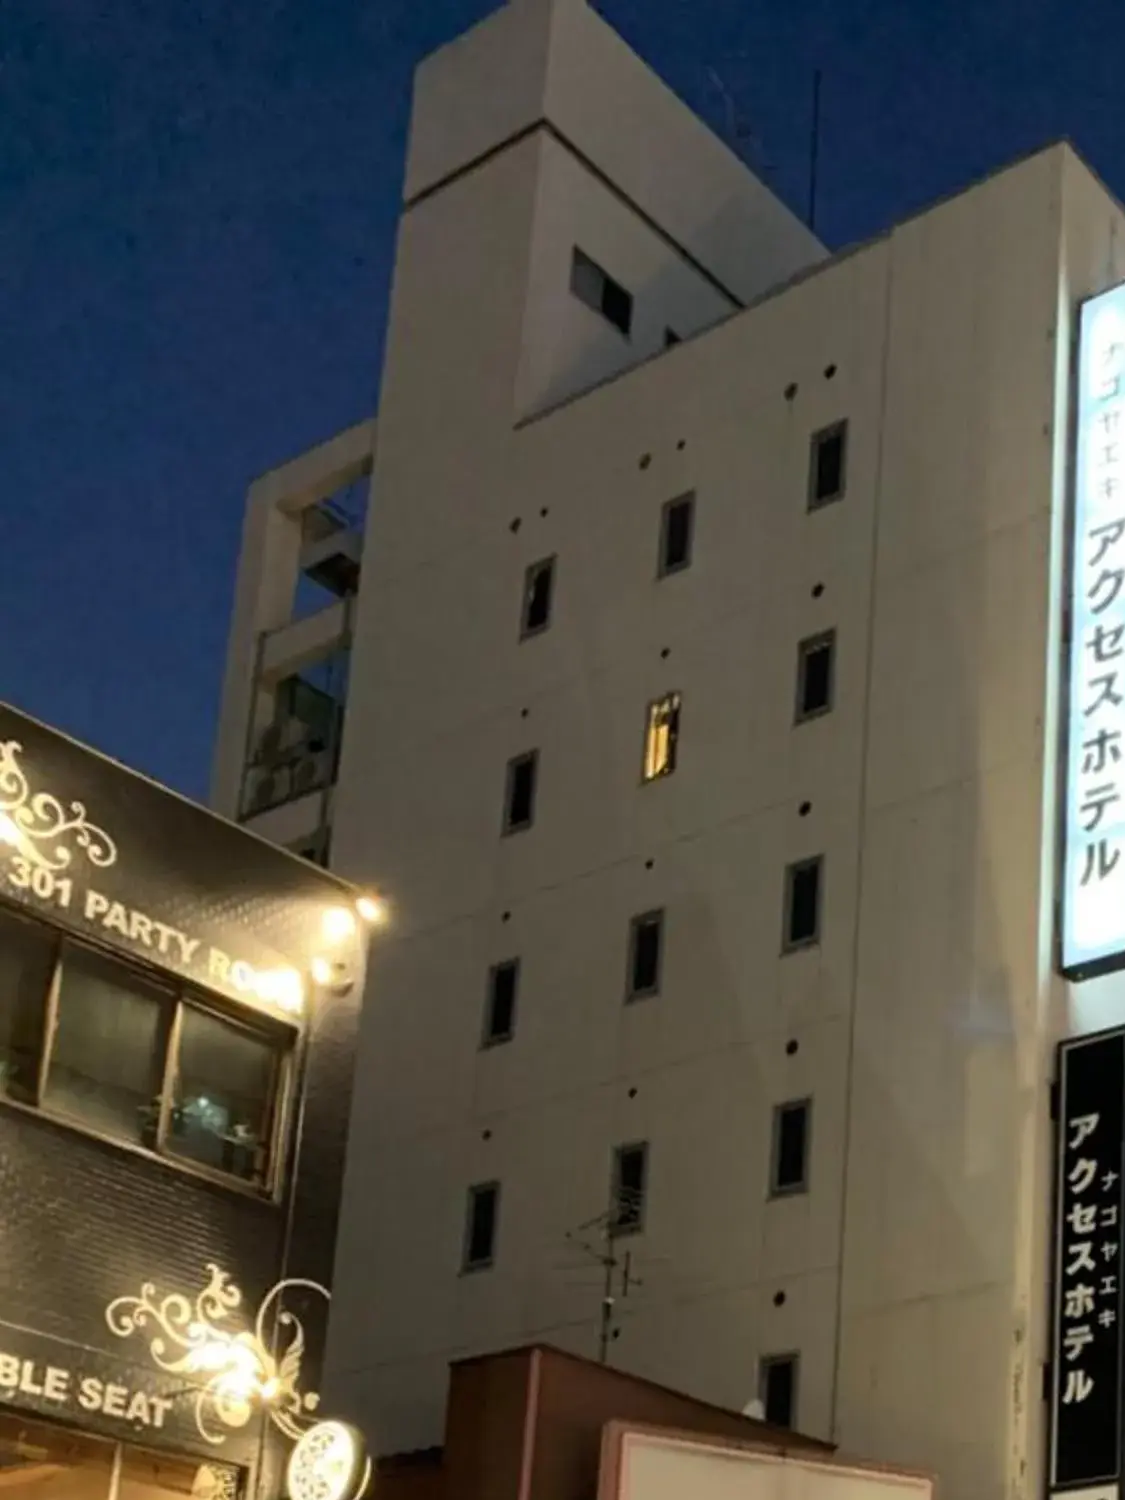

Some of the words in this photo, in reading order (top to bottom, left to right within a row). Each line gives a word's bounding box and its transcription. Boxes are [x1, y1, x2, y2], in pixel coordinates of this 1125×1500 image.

[8, 855, 73, 908] 301
[84, 889, 200, 964] PARTY
[207, 946, 304, 1014] RO
[1062, 1112, 1101, 1405] アクセスホテル
[1098, 1168, 1119, 1329] ナゴヤエキ
[78, 1377, 173, 1428] SEAT
